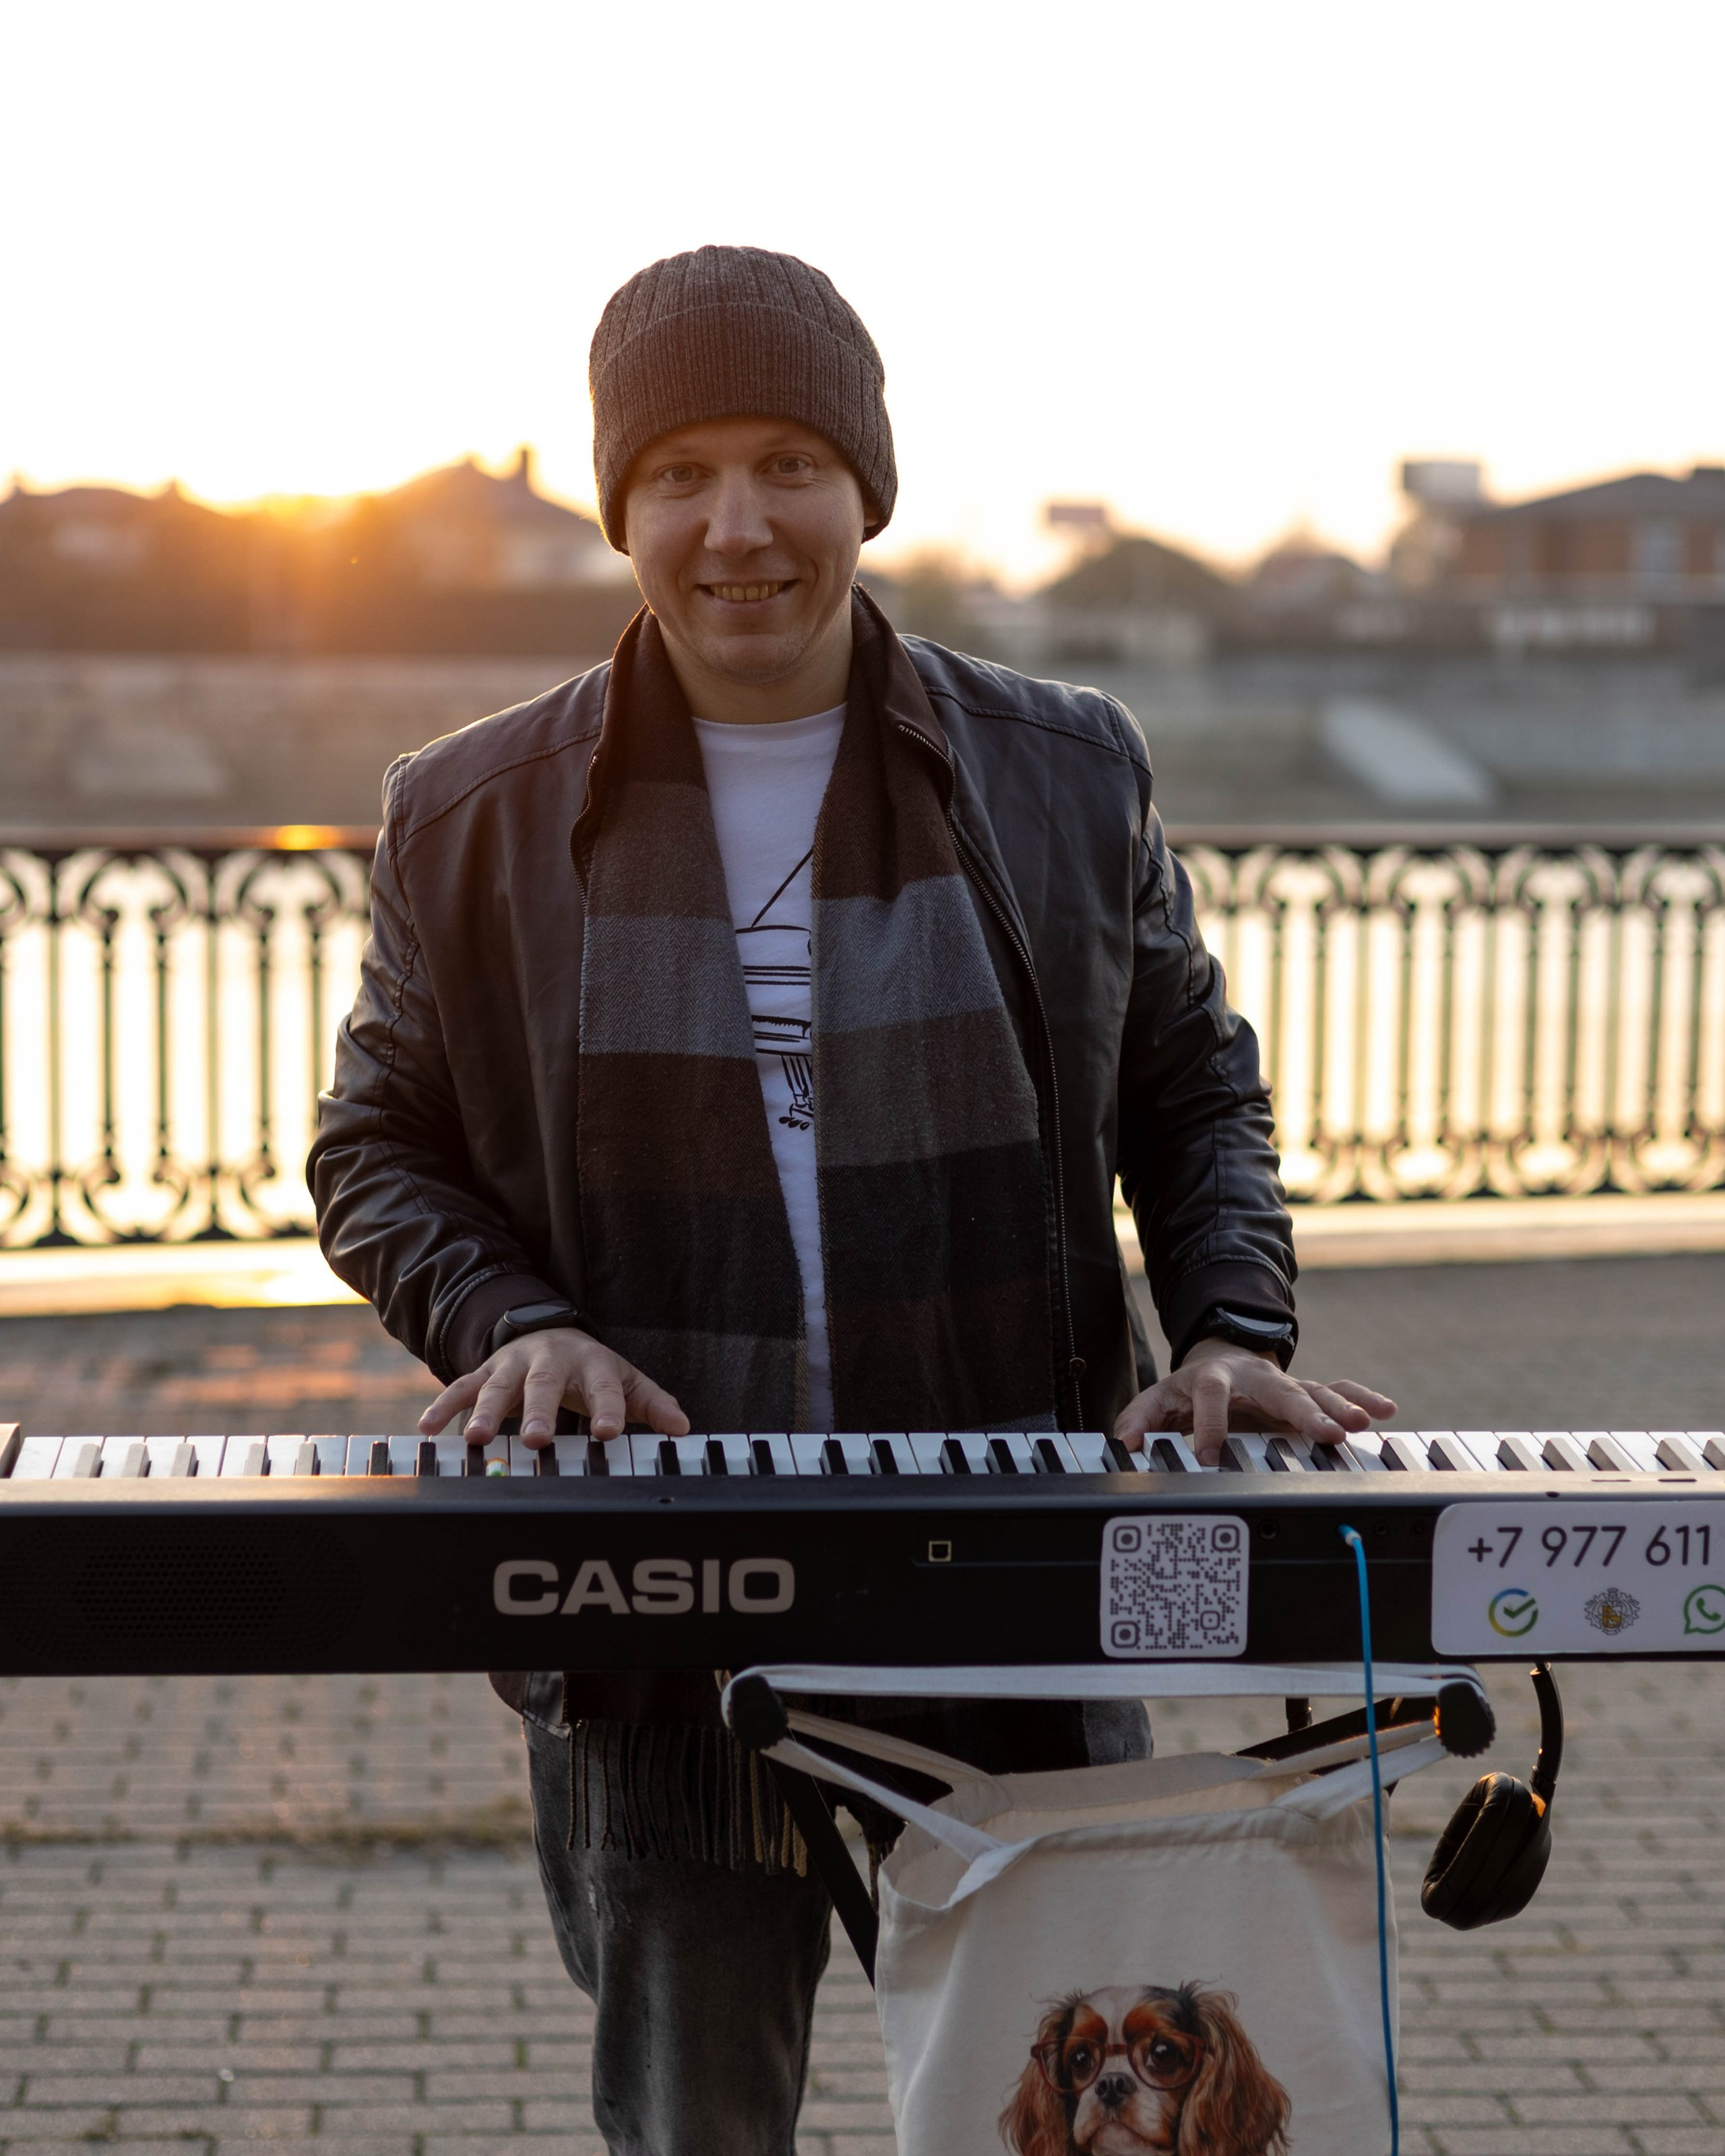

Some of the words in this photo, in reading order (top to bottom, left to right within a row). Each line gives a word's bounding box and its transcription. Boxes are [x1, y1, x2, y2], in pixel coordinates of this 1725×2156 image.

[1468, 1526, 1523, 1568] +7
[1542, 1525, 1627, 1567] 977
[1645, 1525, 1710, 1566] 611
[493, 1558, 795, 1616] CASIO
